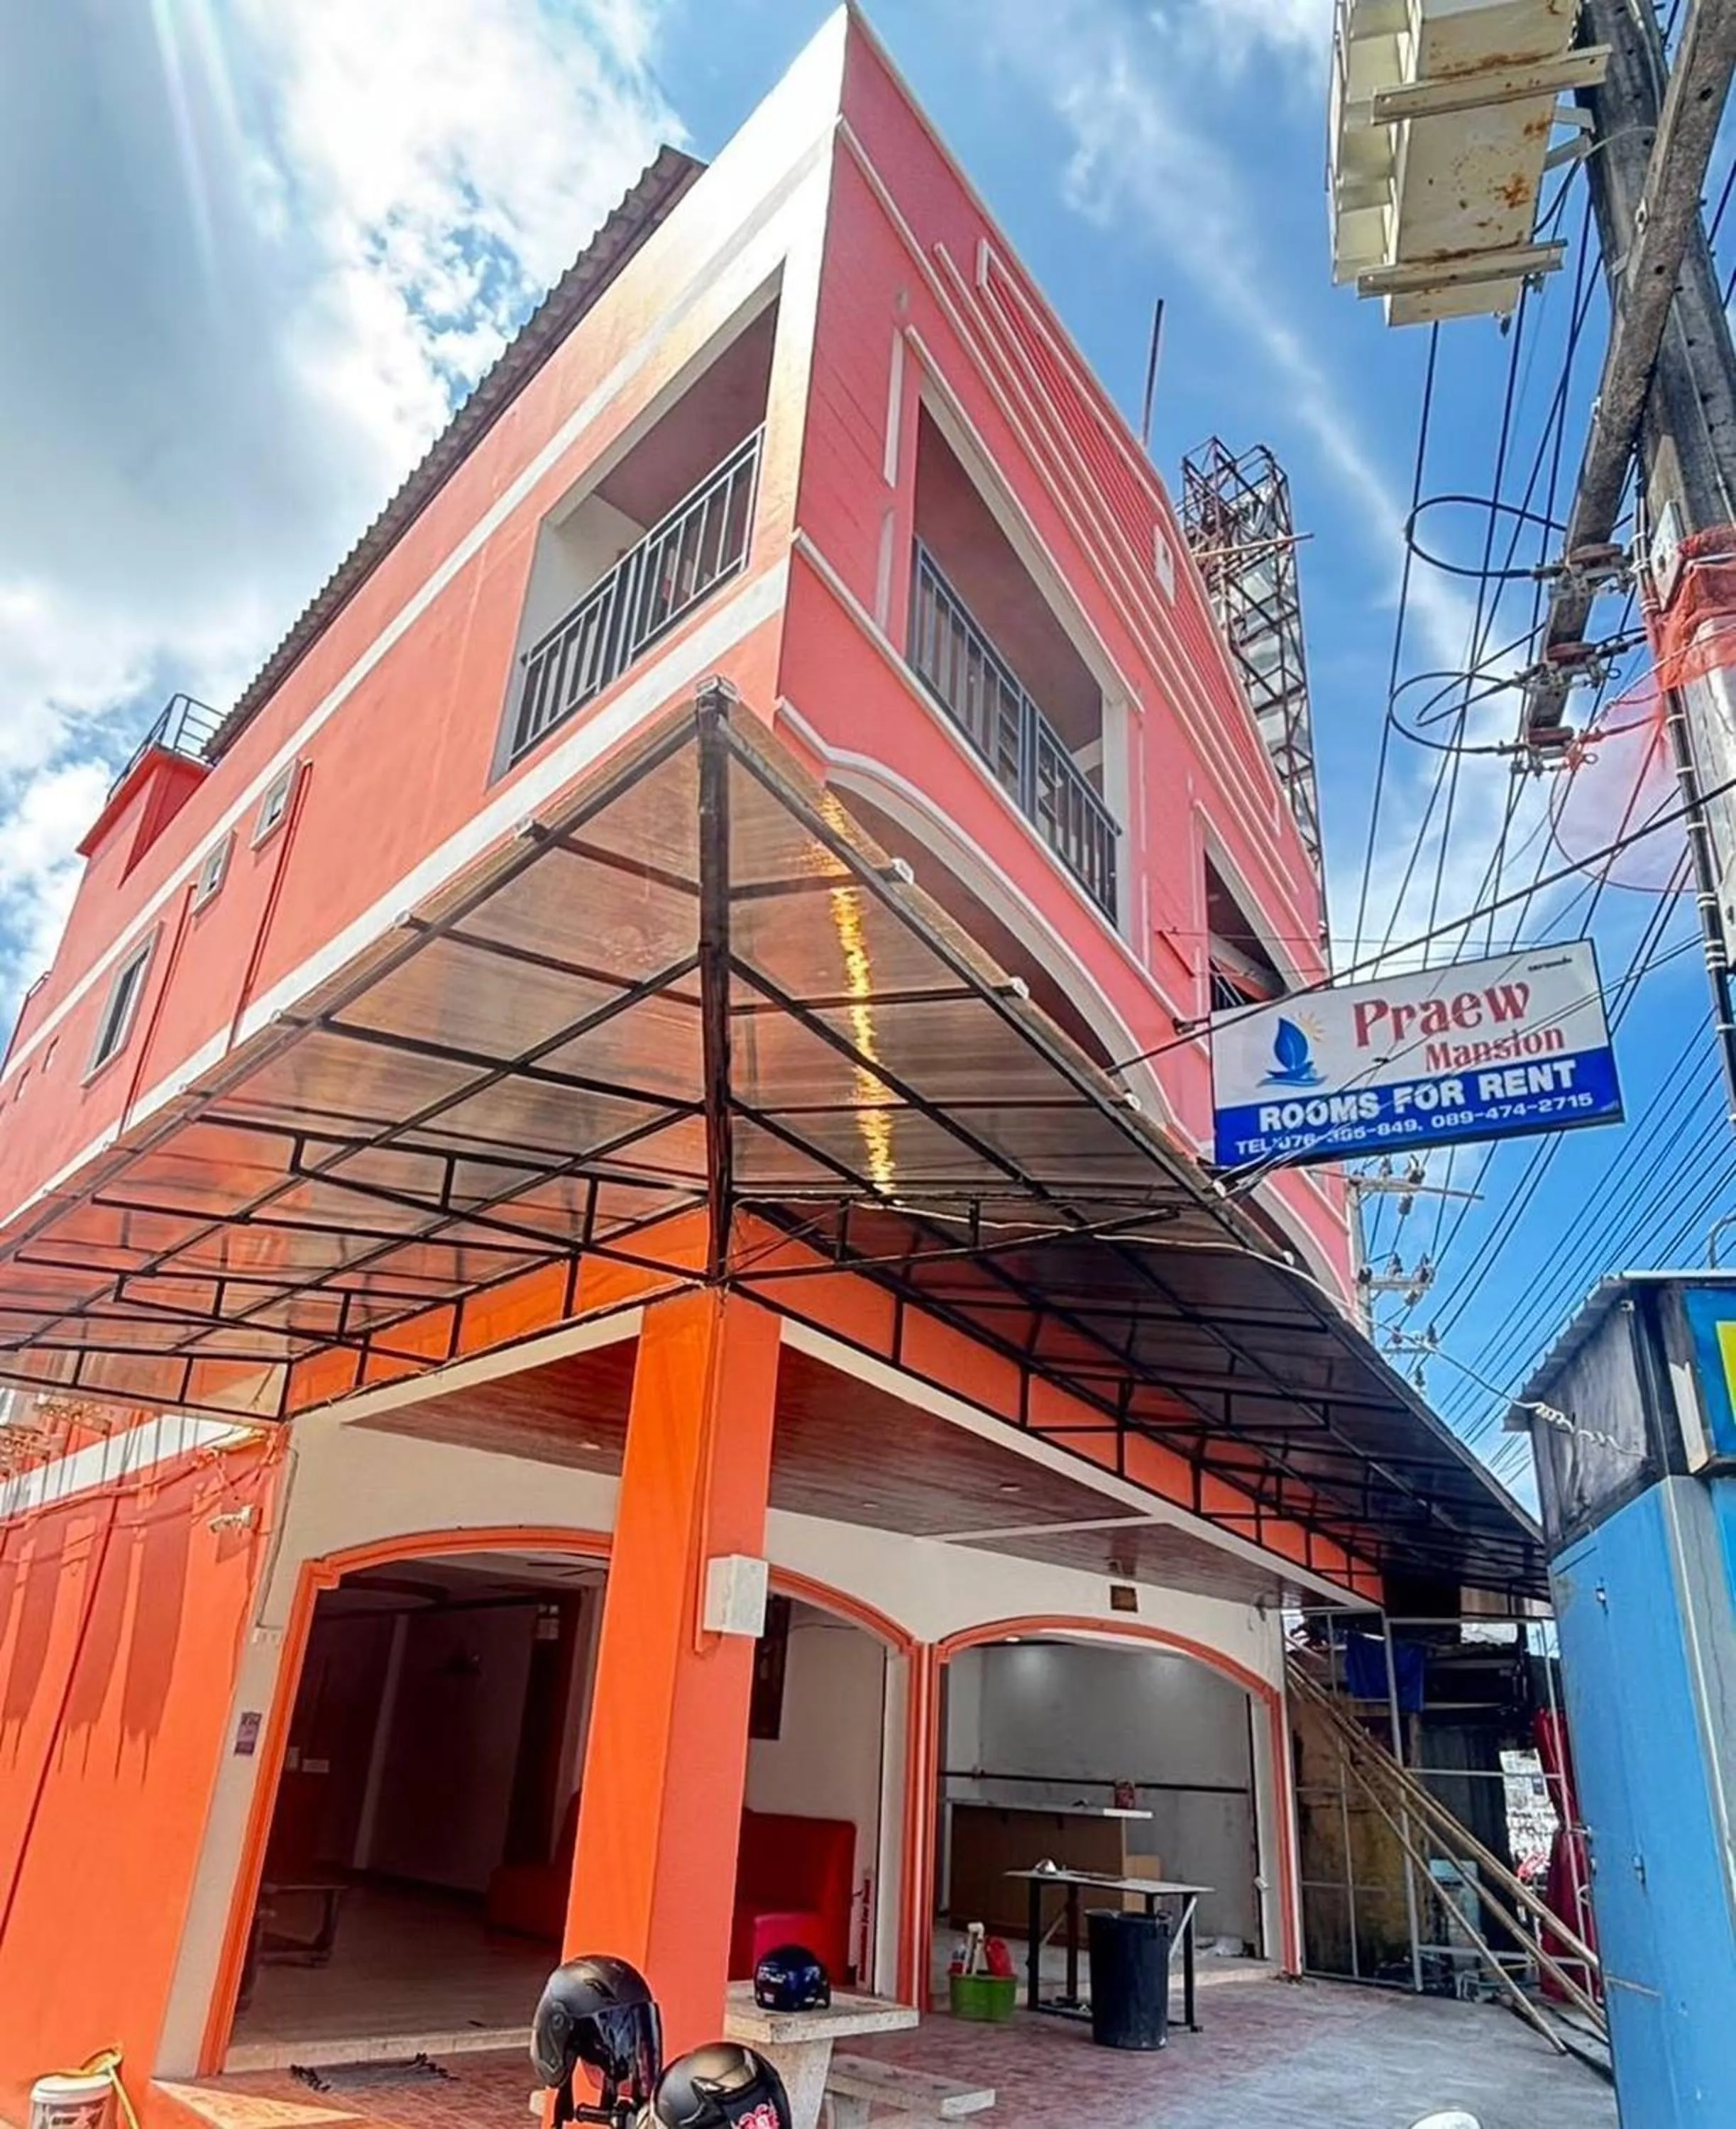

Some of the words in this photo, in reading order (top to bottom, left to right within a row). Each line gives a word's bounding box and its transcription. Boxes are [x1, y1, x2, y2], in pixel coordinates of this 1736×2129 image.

[1353, 981, 1530, 1047] Praew
[1426, 1028, 1565, 1072] Mansion
[1259, 1091, 1380, 1133] ROOMS
[1392, 1079, 1466, 1113] FOR
[1478, 1060, 1576, 1101] RENT
[1431, 1092, 1593, 1128] 089-474-2715
